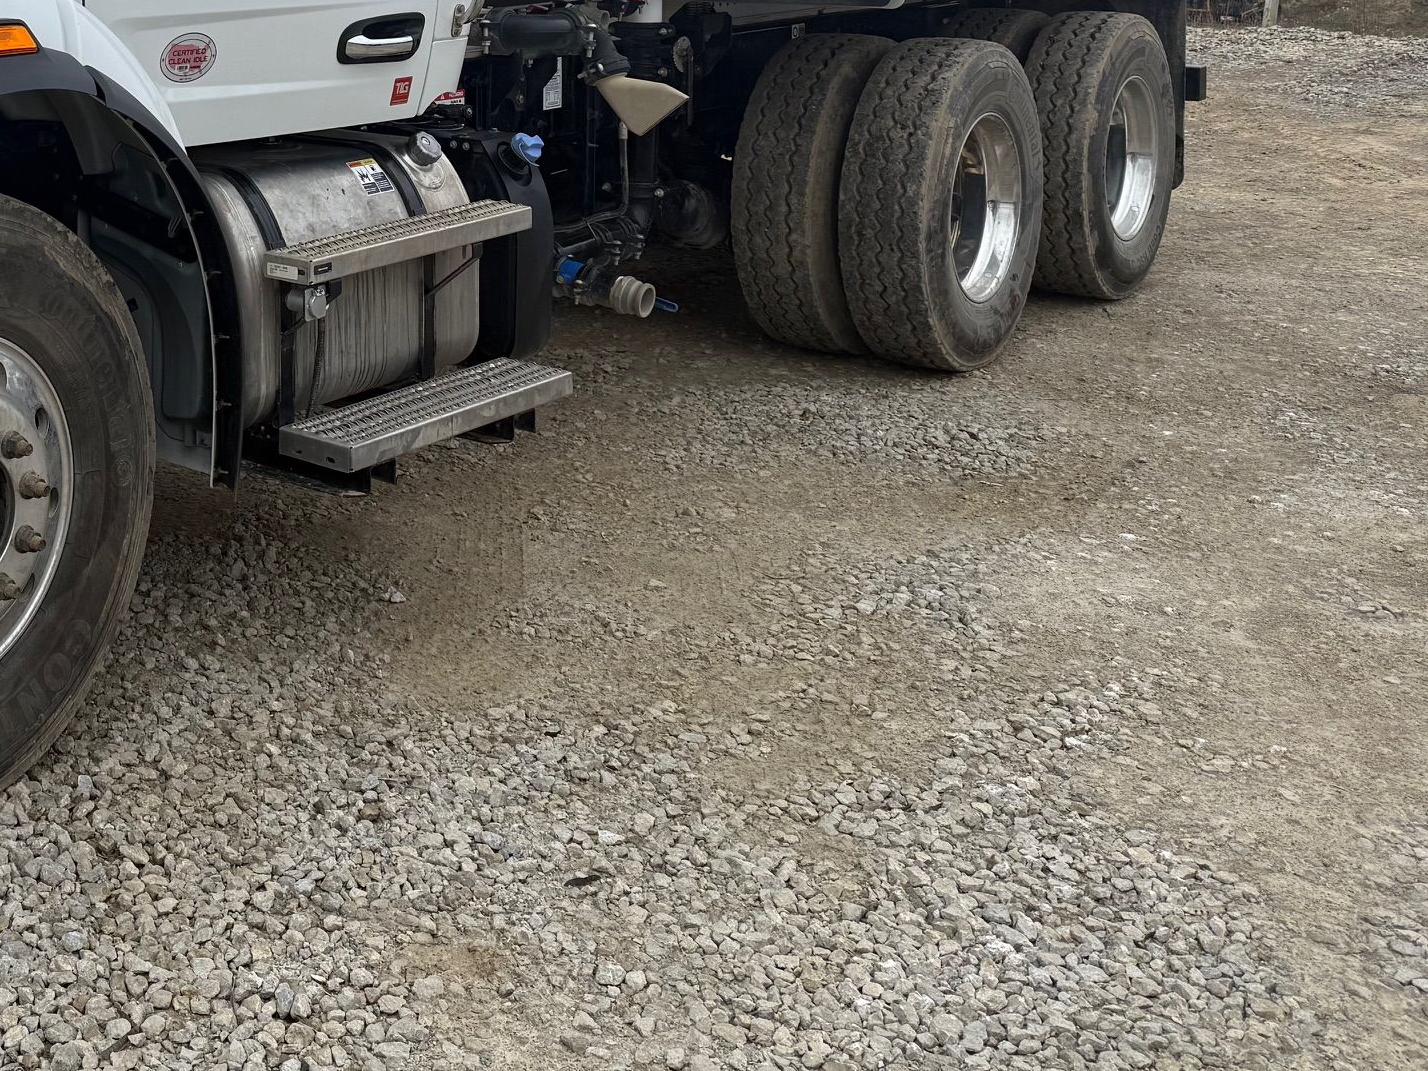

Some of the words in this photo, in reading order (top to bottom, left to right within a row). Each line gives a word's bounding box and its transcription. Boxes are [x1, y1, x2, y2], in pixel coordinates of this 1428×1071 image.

[172, 47, 207, 57] CERTIFIED
[168, 57, 192, 65] CLEAN
[193, 55, 209, 63] IDLE
